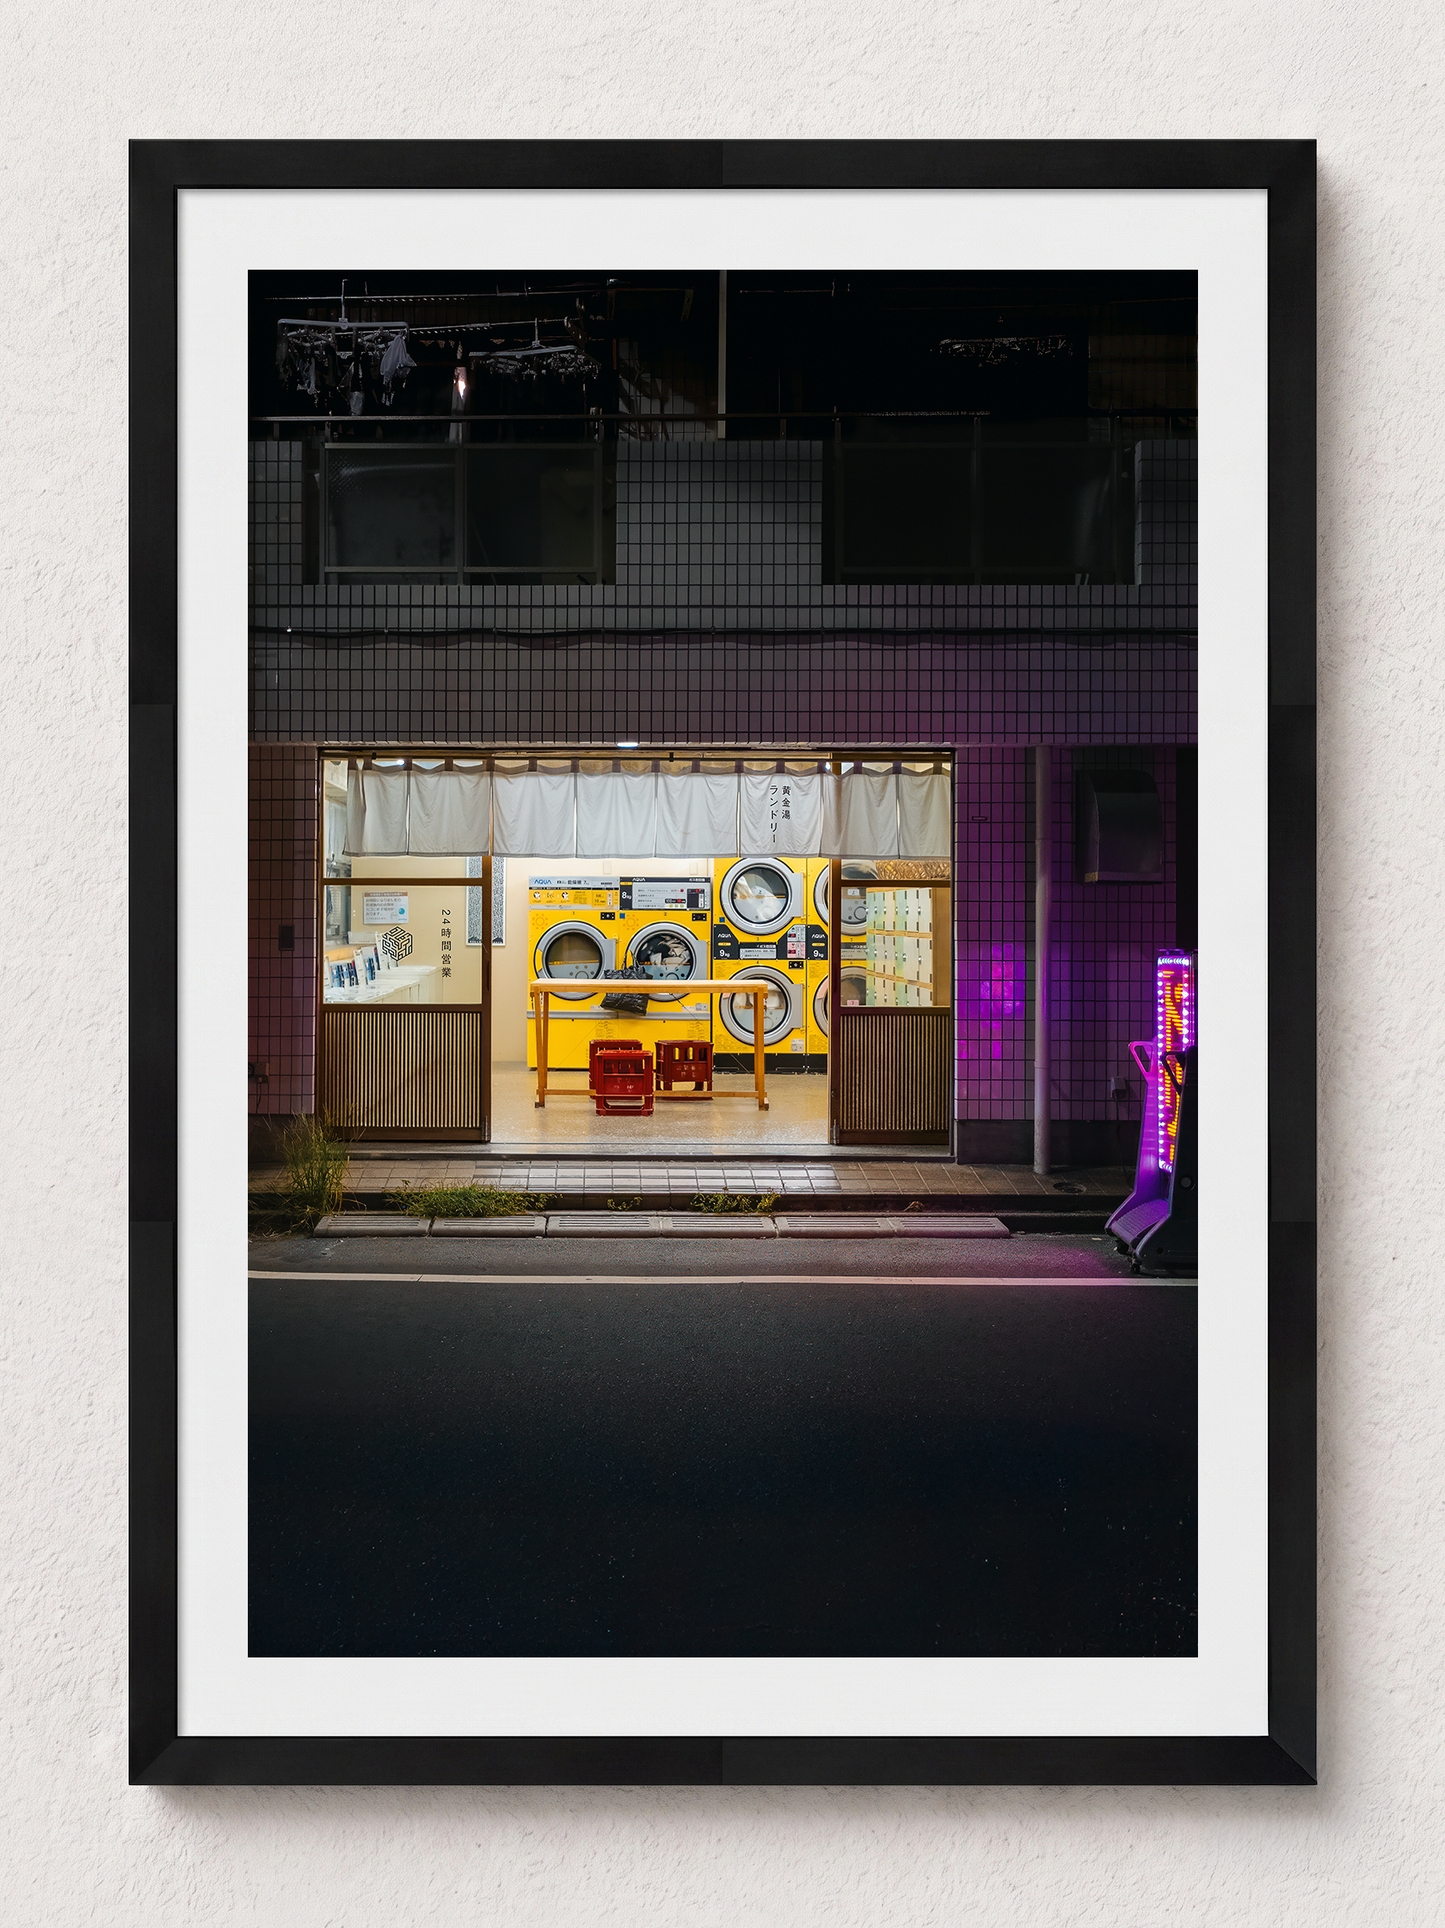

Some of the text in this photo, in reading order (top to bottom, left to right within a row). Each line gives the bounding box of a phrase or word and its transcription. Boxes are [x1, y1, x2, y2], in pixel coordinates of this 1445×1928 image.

[782, 785, 791, 820] 黄金湯
[770, 785, 778, 843] ランドリー
[621, 891, 632, 900] 8kg
[441, 909, 452, 978] 24時間営業
[719, 949, 730, 957] 9kg
[813, 950, 824, 958] 9kg
